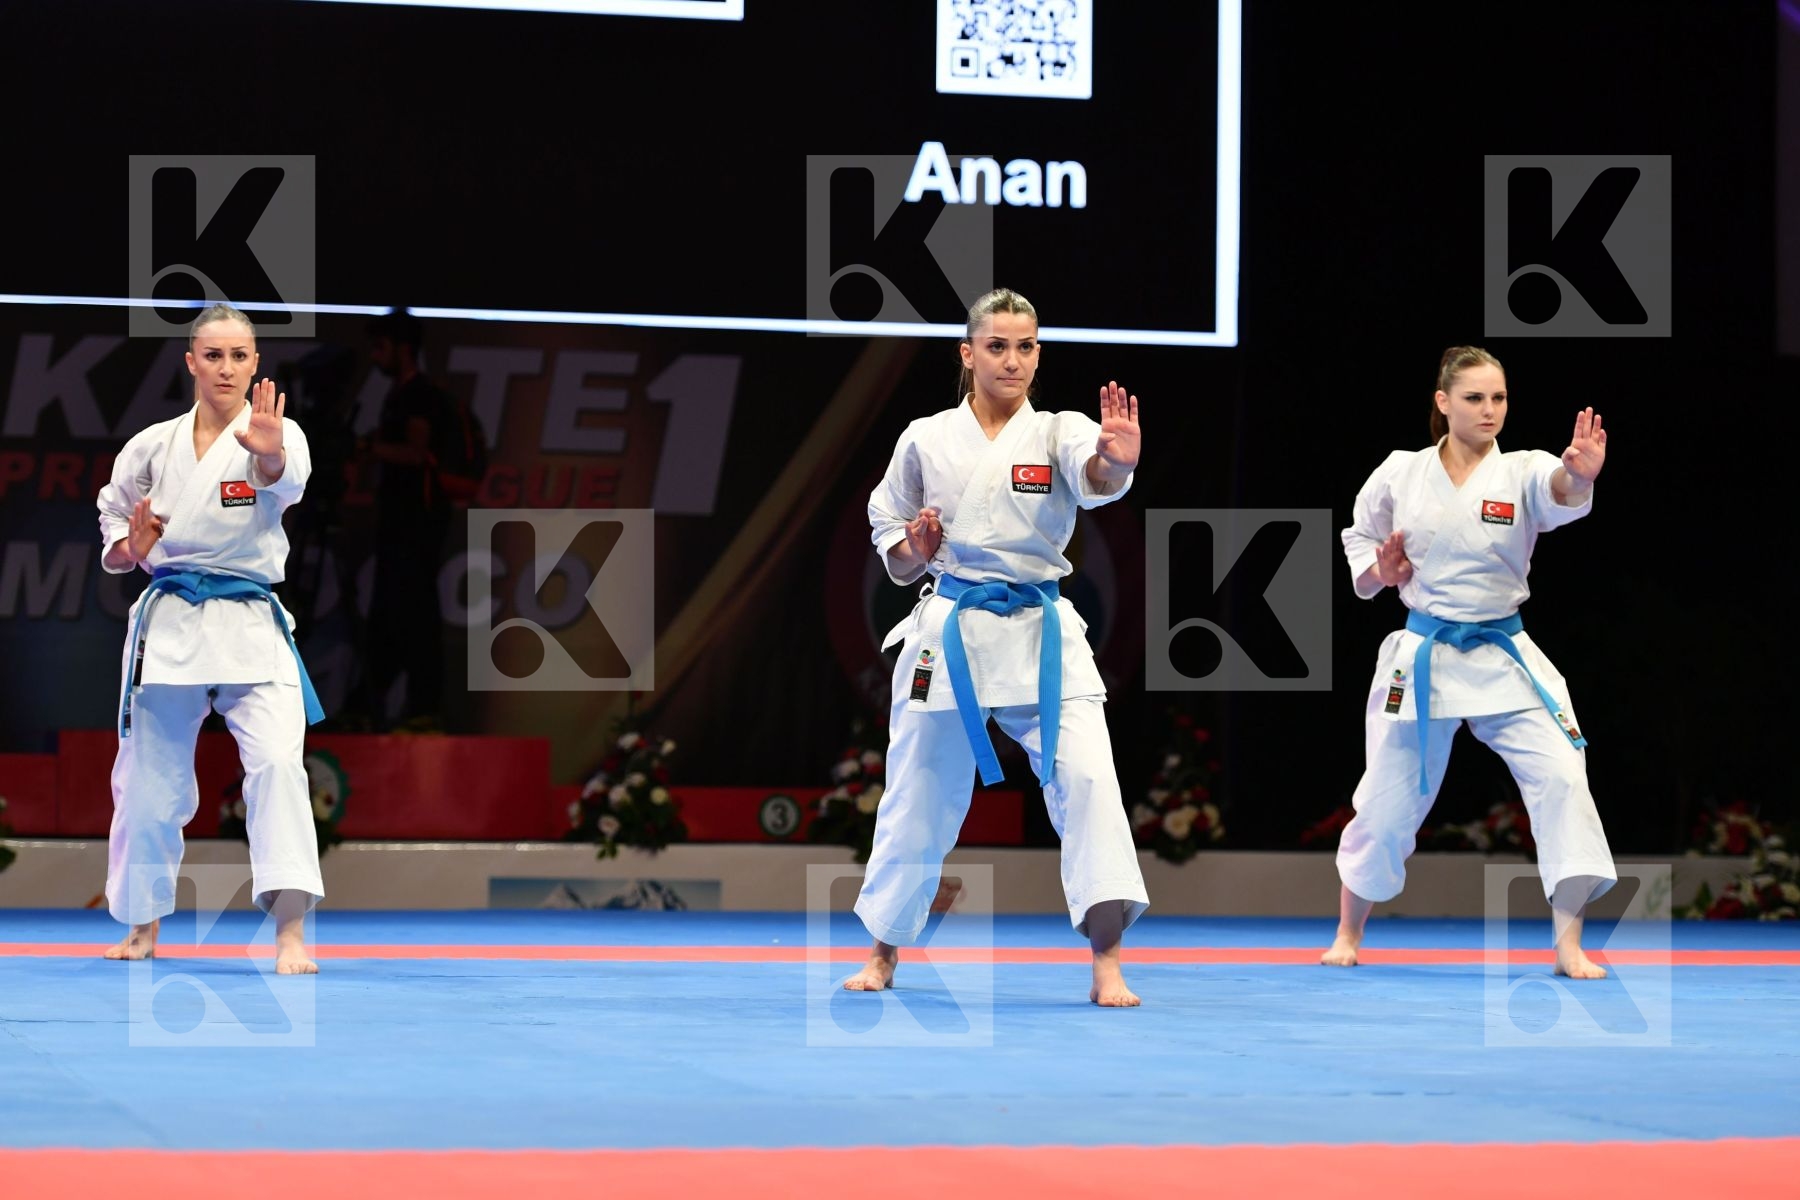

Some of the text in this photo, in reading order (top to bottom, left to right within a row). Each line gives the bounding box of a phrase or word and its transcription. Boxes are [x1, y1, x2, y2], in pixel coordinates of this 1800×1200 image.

[904, 141, 1088, 208] Anan
[1016, 484, 1049, 492] TÜRKİYE
[772, 803, 788, 829] 3
